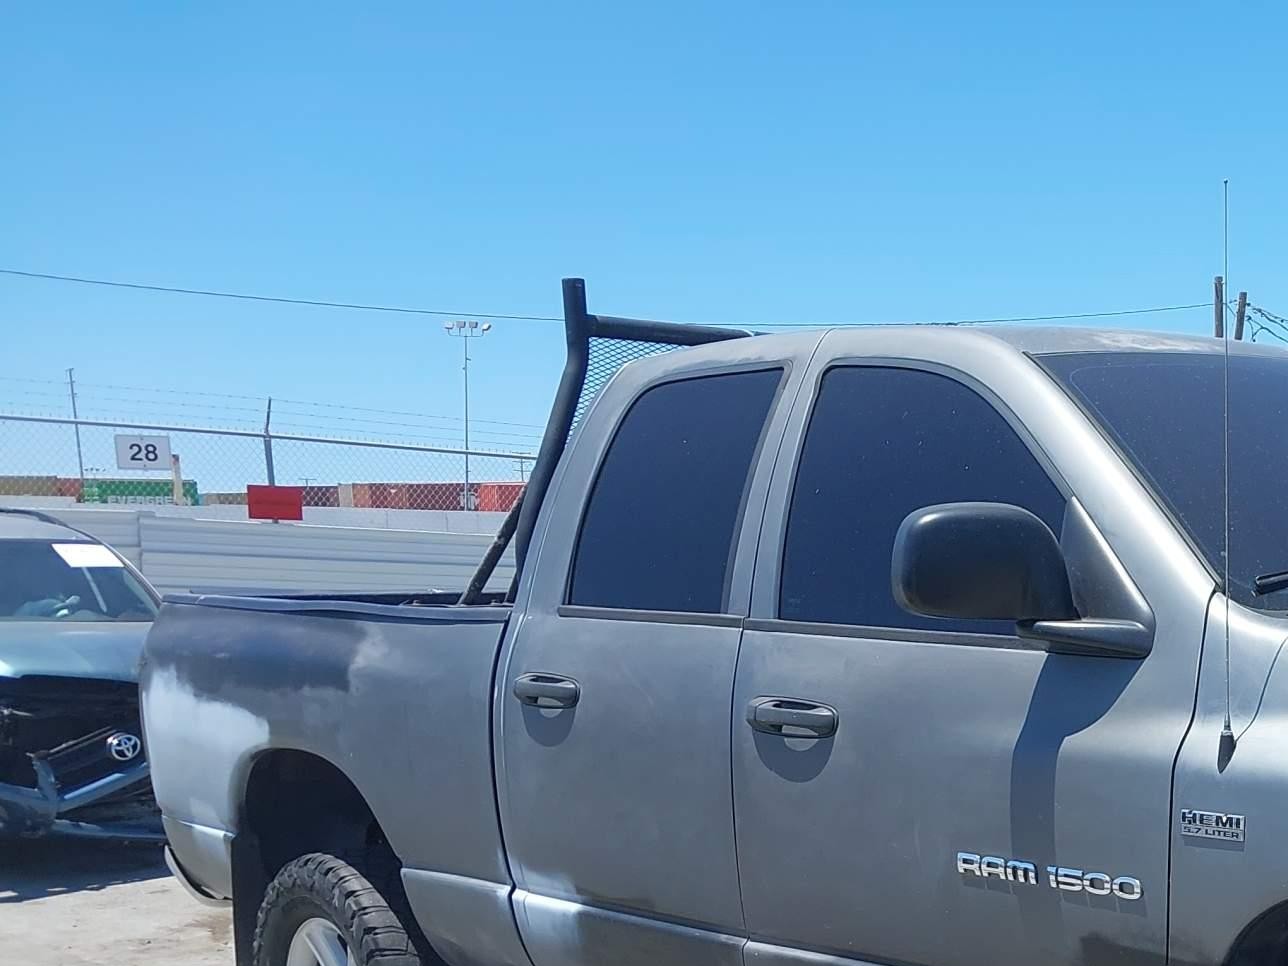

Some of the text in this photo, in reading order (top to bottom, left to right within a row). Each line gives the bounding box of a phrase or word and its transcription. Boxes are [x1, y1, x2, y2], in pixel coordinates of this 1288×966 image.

[128, 443, 158, 462] 28
[108, 495, 192, 505] EVERGREN
[1181, 811, 1242, 829] HEMI
[1183, 826, 1239, 839] 5.7 LITER
[957, 852, 1144, 900] RAM 1500
